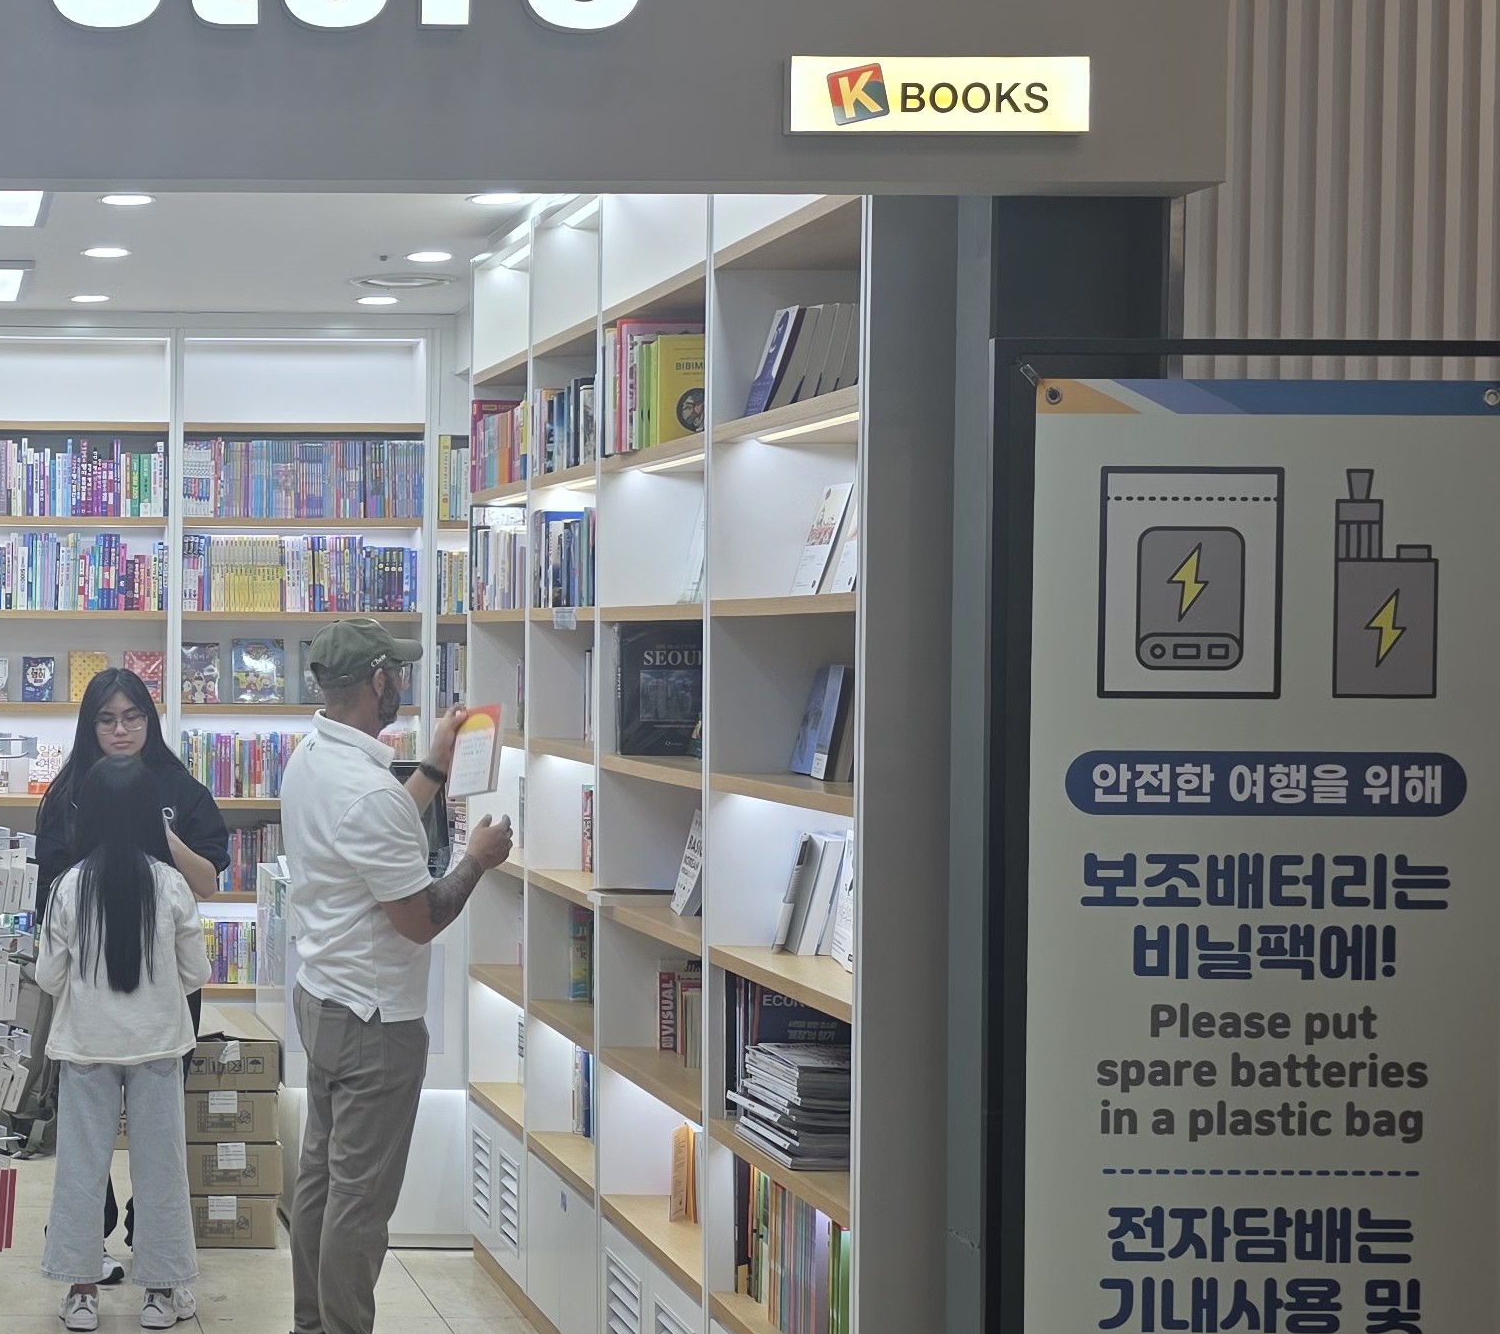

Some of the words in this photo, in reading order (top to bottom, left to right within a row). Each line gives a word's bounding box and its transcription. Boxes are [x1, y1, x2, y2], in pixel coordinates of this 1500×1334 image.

[900, 81, 1049, 114] BOOKS
[676, 362, 705, 371] BIBIM
[1093, 764, 1214, 802] 안전한
[1229, 764, 1348, 803] 여행을
[1364, 765, 1441, 804] 위해
[1081, 853, 1451, 910] 보조배터리는
[1134, 924, 1396, 980] 비닐팩에!
[662, 980, 674, 1036] VISUAL
[1151, 1003, 1291, 1039] Please
[1305, 1006, 1377, 1045] put
[1097, 1060, 1217, 1094] spare
[1232, 1052, 1428, 1088] batteries
[1101, 1100, 1137, 1134] in
[1152, 1109, 1174, 1135] a
[1189, 1101, 1332, 1142] plastic
[1346, 1102, 1423, 1143] bag
[1108, 1206, 1414, 1263] 전자담배는
[1099, 1277, 1342, 1334] 기내사용
[1365, 1279, 1422, 1334] 및
